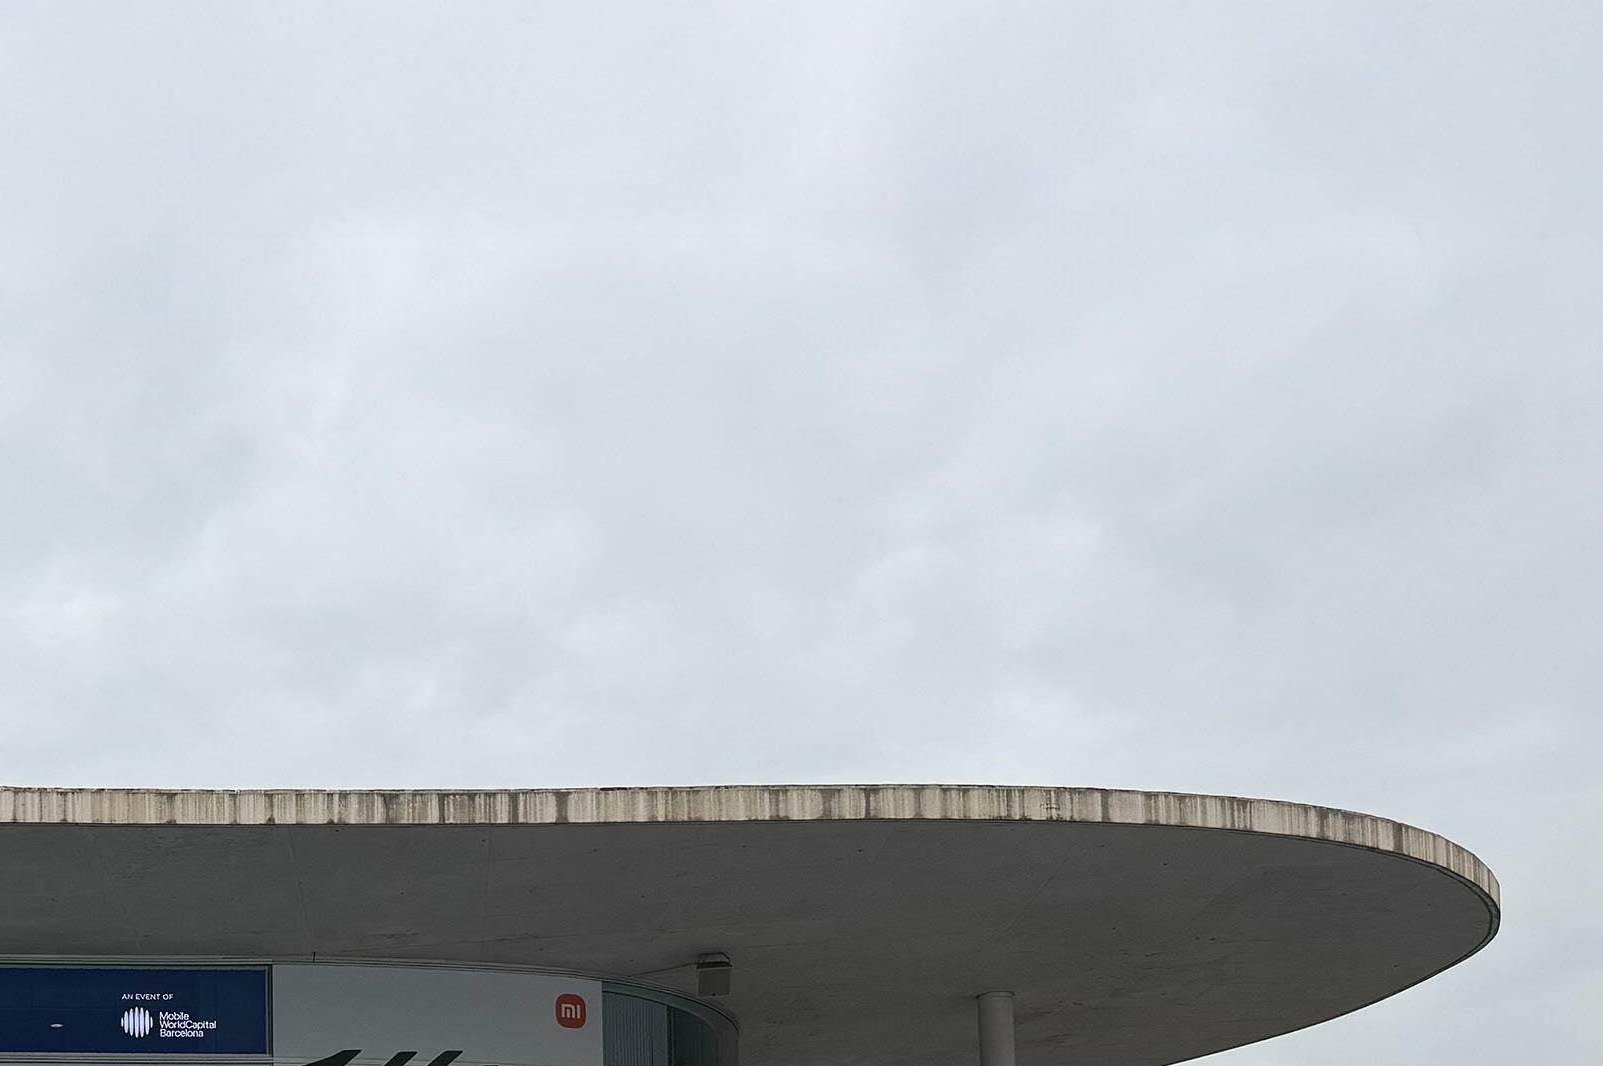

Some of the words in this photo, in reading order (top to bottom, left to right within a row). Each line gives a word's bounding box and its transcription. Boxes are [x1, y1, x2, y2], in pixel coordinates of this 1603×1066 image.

[135, 993, 161, 1001] EVENT
[162, 993, 174, 1001] OF
[159, 1011, 190, 1021] Mobile
[159, 1020, 217, 1031] WorldCapital
[159, 1028, 204, 1038] Barcelona
